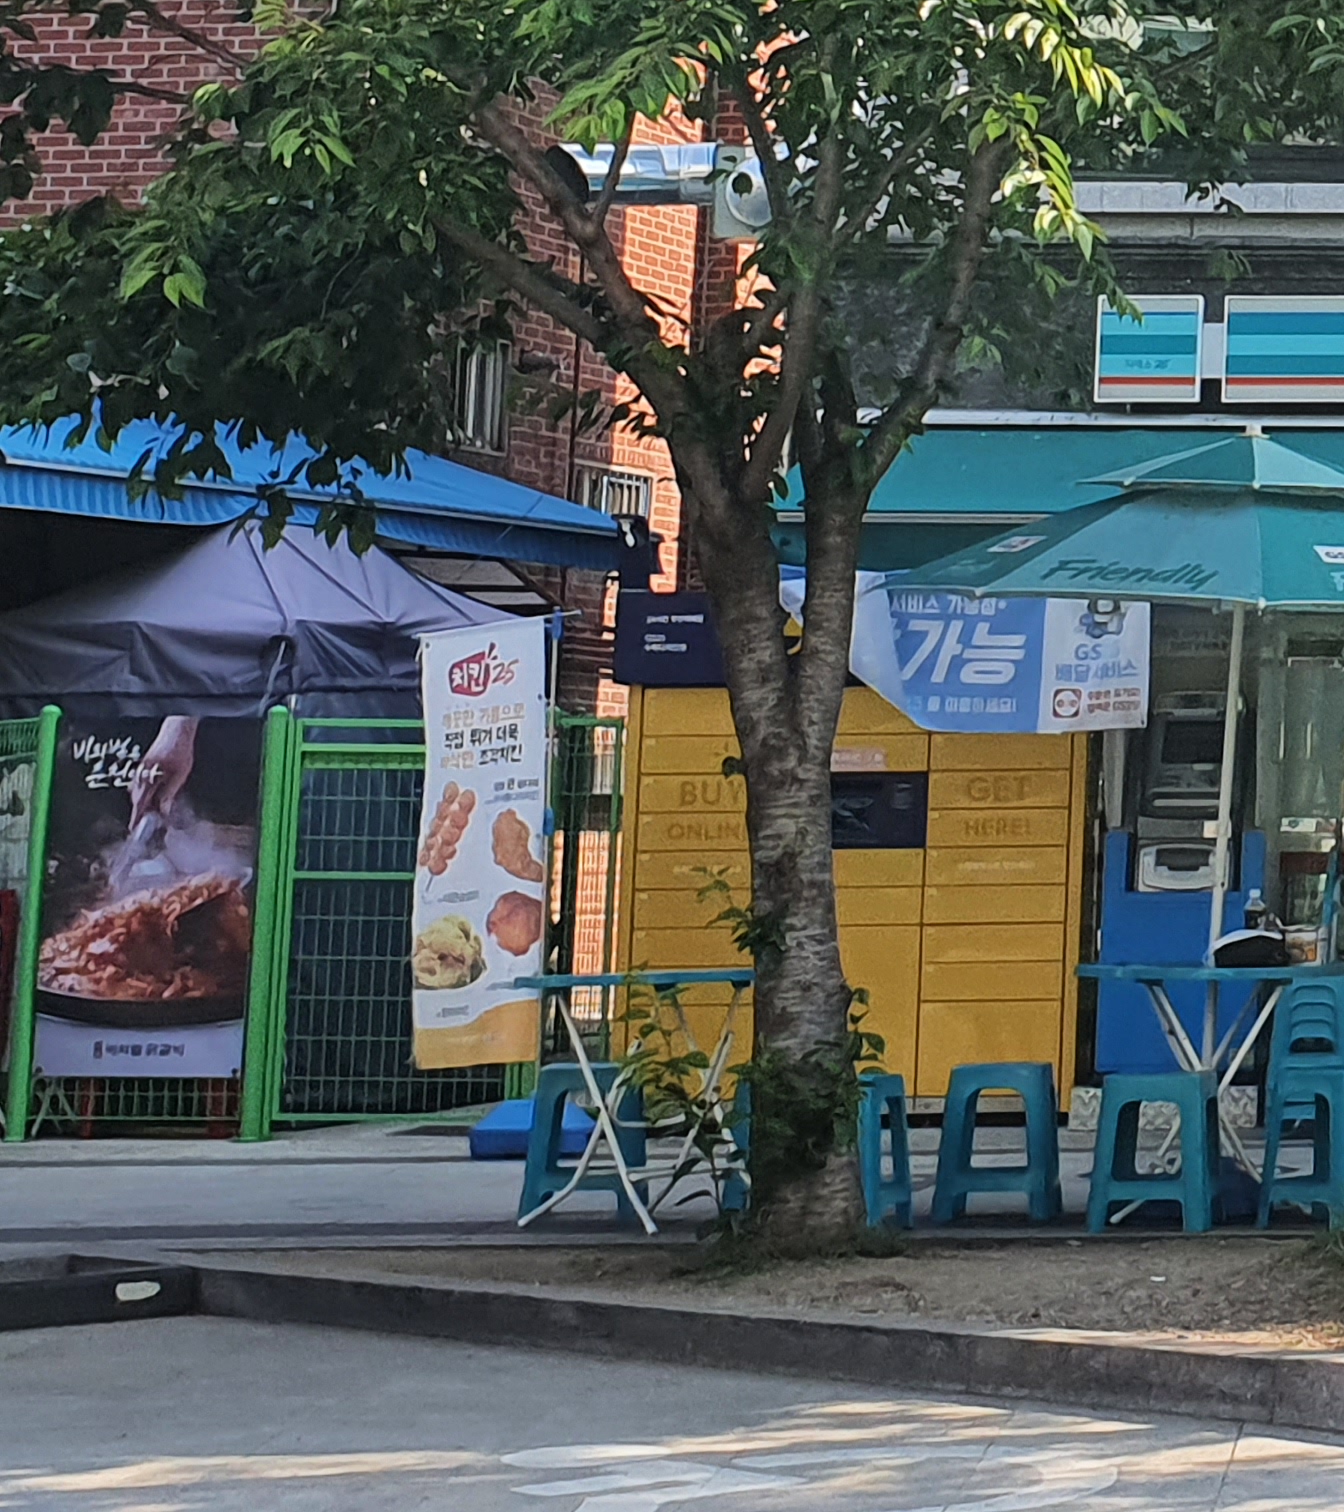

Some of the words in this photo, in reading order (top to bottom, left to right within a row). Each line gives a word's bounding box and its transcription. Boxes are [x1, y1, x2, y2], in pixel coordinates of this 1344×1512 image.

[1040, 558, 1220, 589] Friendly
[902, 619, 1027, 684] 가능
[966, 776, 1027, 802] GET
[667, 821, 746, 841] ONLIN
